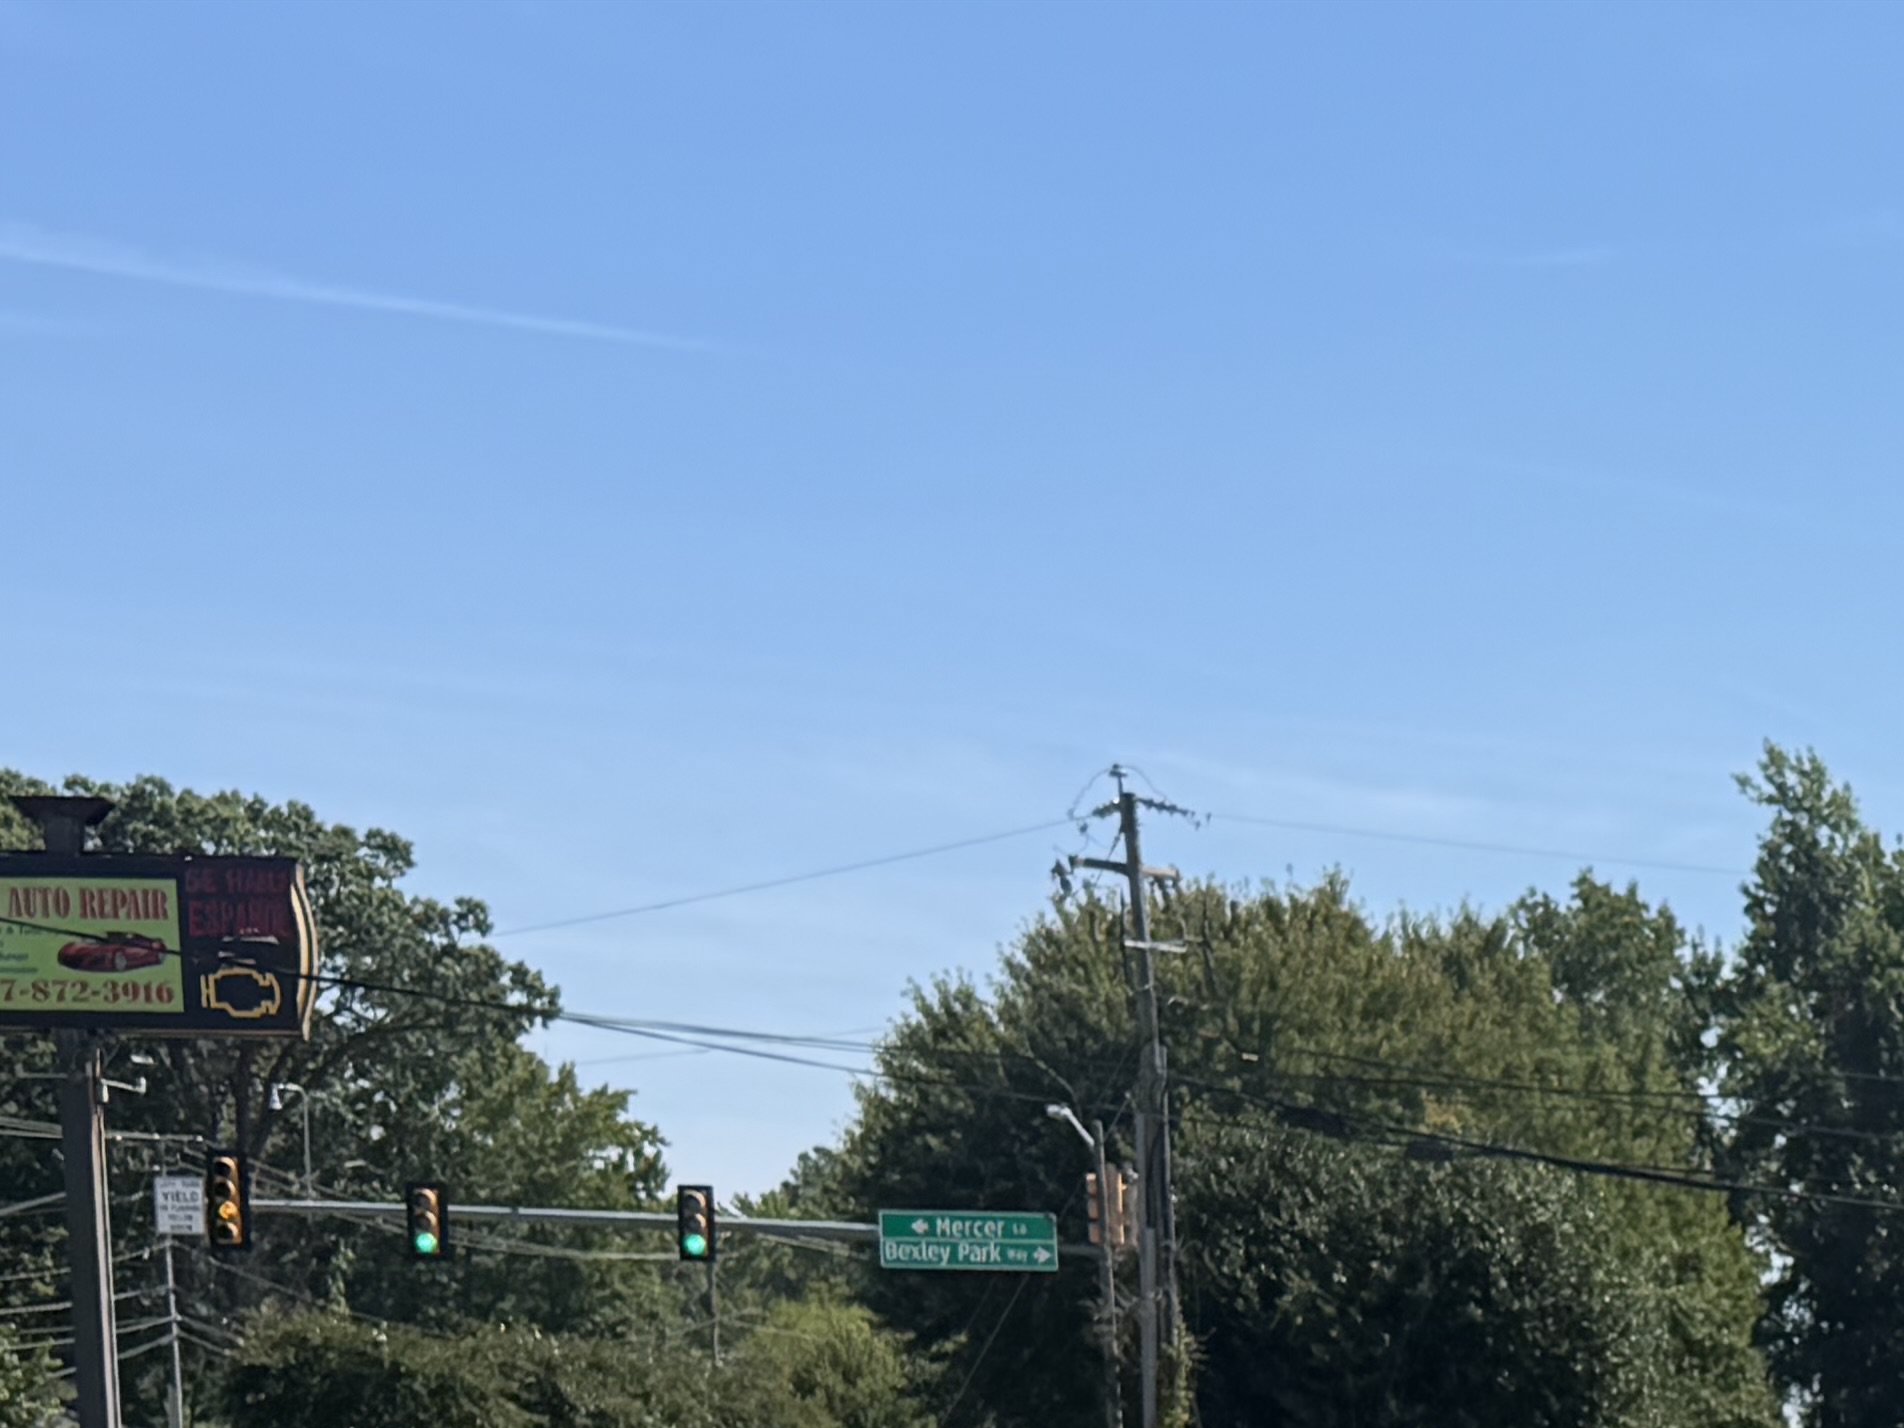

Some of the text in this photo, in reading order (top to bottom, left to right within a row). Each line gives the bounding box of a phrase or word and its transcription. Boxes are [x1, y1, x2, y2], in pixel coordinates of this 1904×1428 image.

[9, 887, 169, 920] AUTO REPAIR
[936, 1218, 1004, 1237] Mercer
[885, 1242, 950, 1266] Bexley
[958, 1244, 1001, 1264] Park
